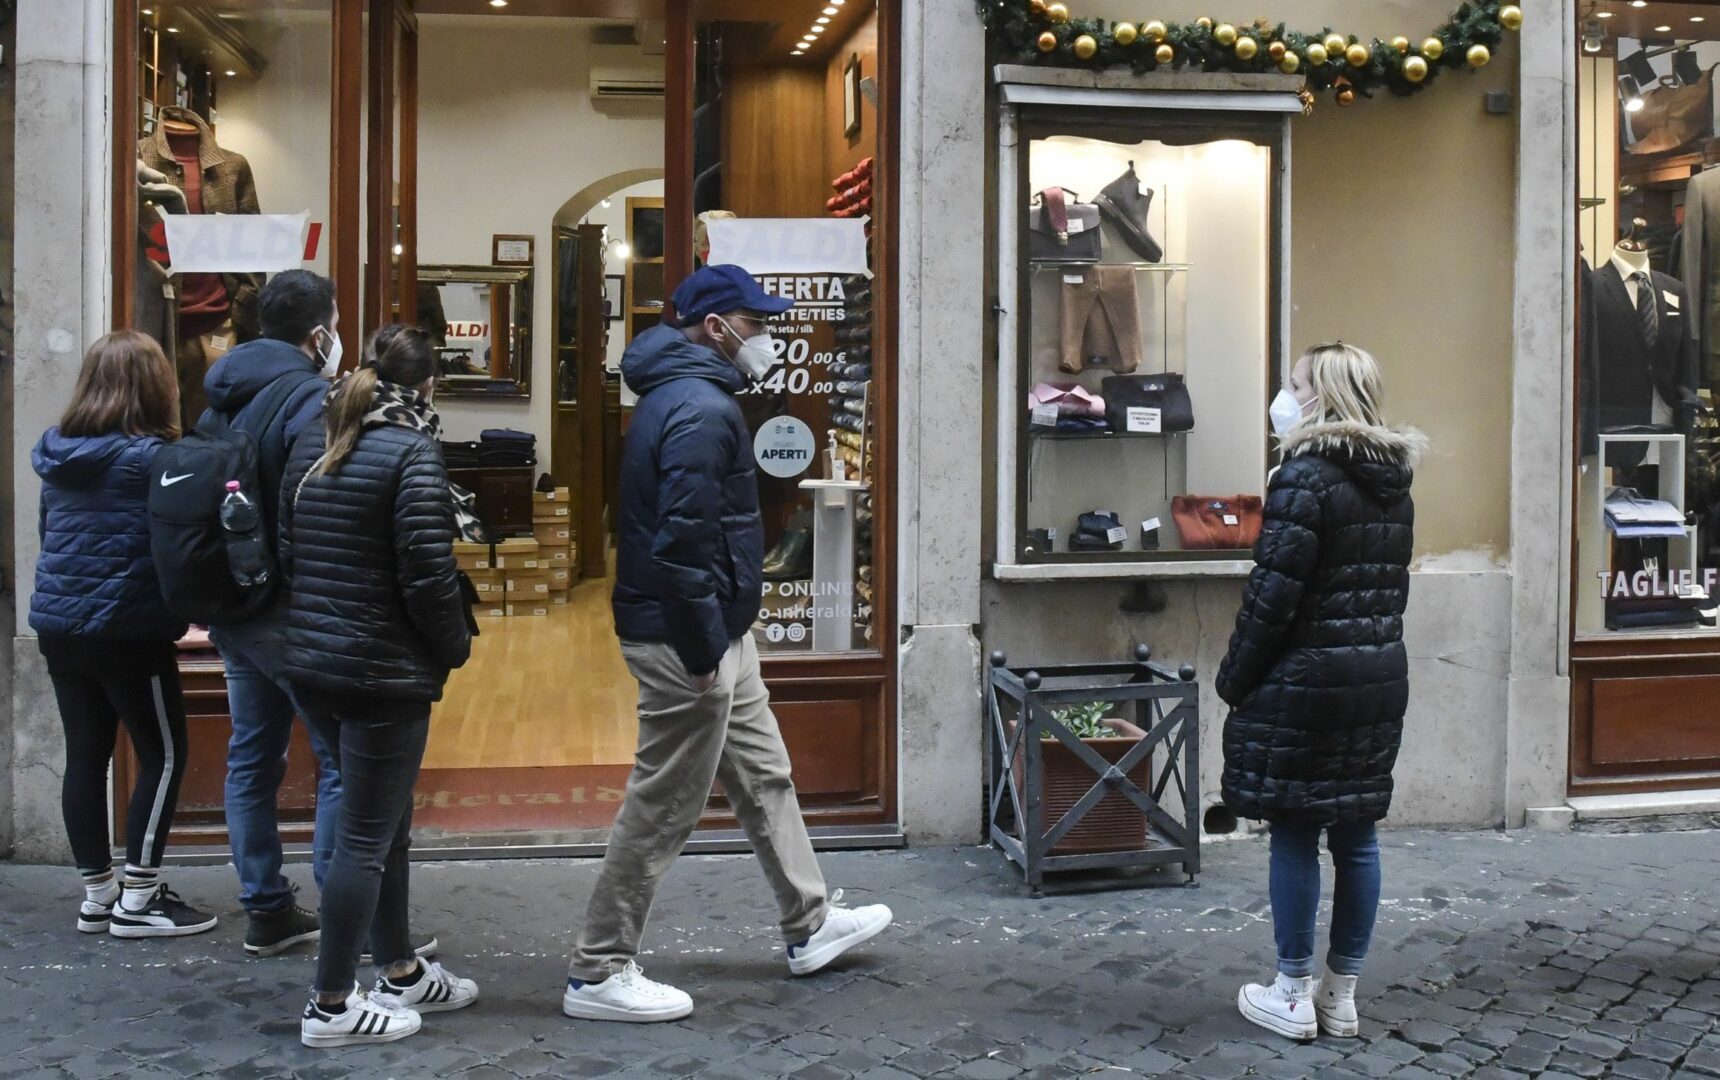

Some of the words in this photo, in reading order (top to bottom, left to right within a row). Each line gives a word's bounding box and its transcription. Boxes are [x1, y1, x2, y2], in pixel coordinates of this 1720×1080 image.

[756, 277, 845, 300] FERTA
[800, 325, 814, 333] silk
[761, 449, 807, 459] APERTI
[778, 582, 853, 597] ONLINE
[1597, 569, 1692, 598] TAGLIE
